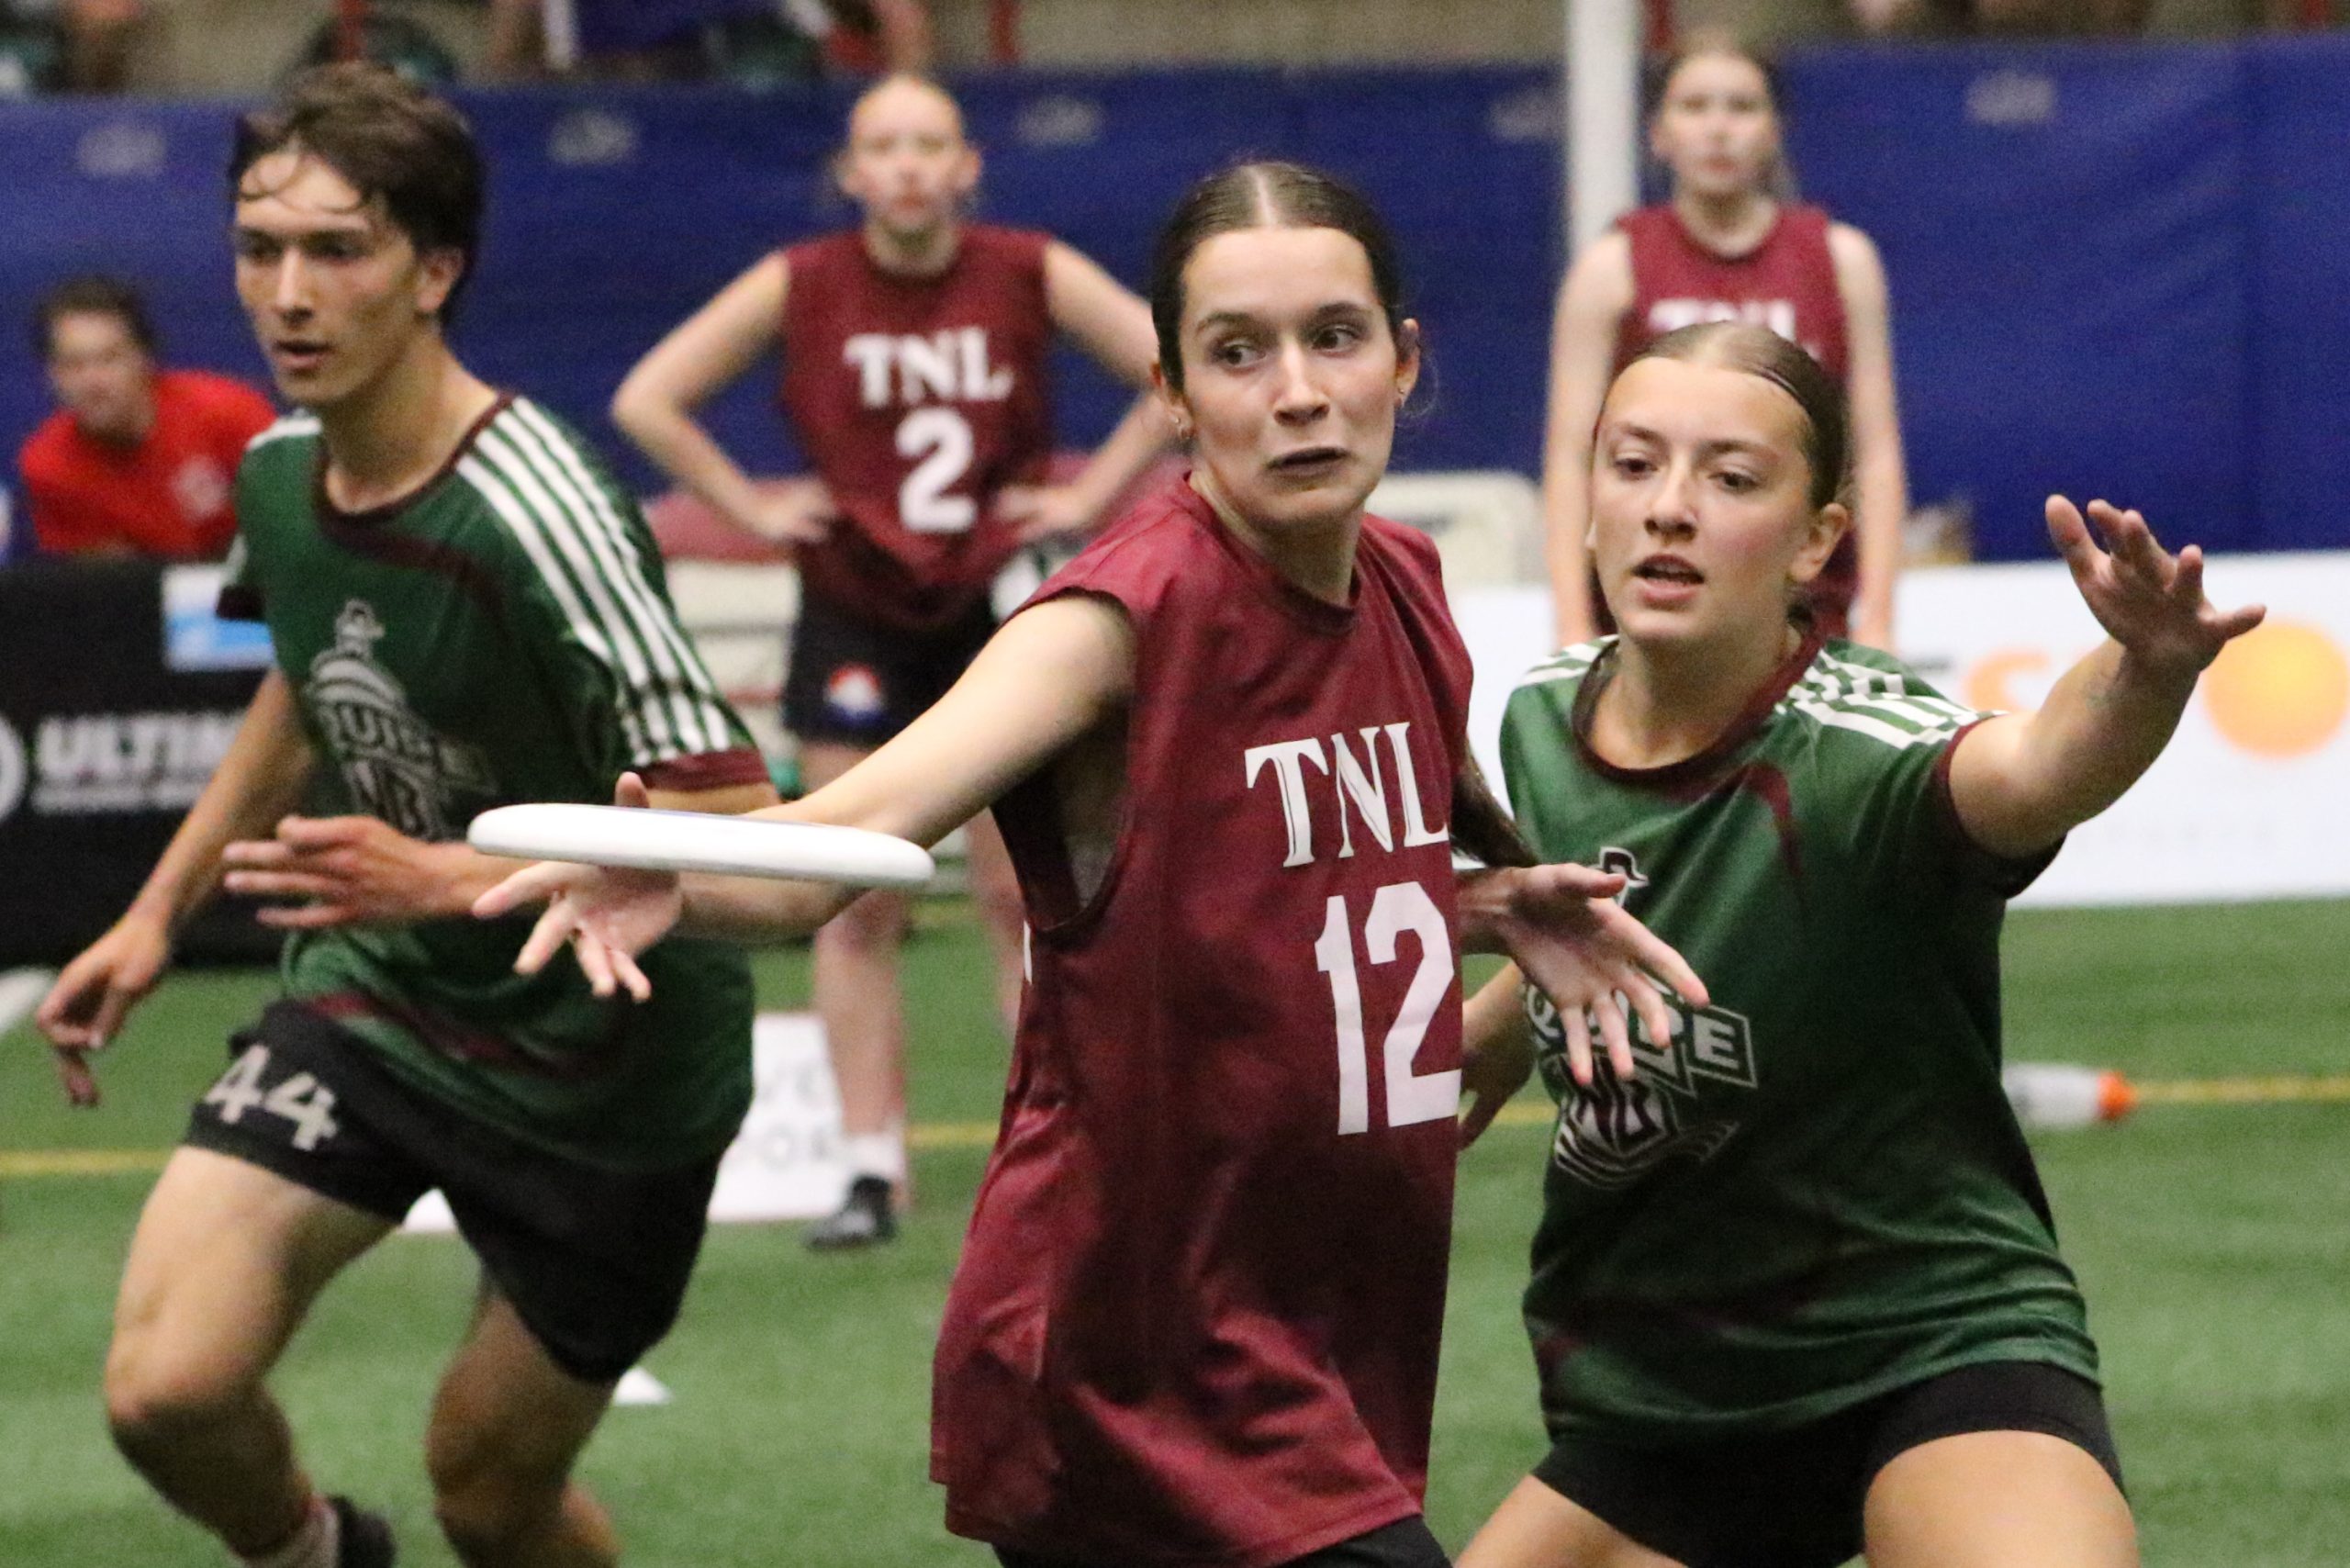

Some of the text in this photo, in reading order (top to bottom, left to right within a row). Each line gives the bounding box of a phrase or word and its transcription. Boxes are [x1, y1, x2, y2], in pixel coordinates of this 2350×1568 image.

[844, 327, 1013, 409] TNL
[896, 409, 978, 532] 2
[1245, 722, 1449, 867] TNL
[1315, 881, 1461, 1135] 12
[205, 1044, 336, 1150] 44
